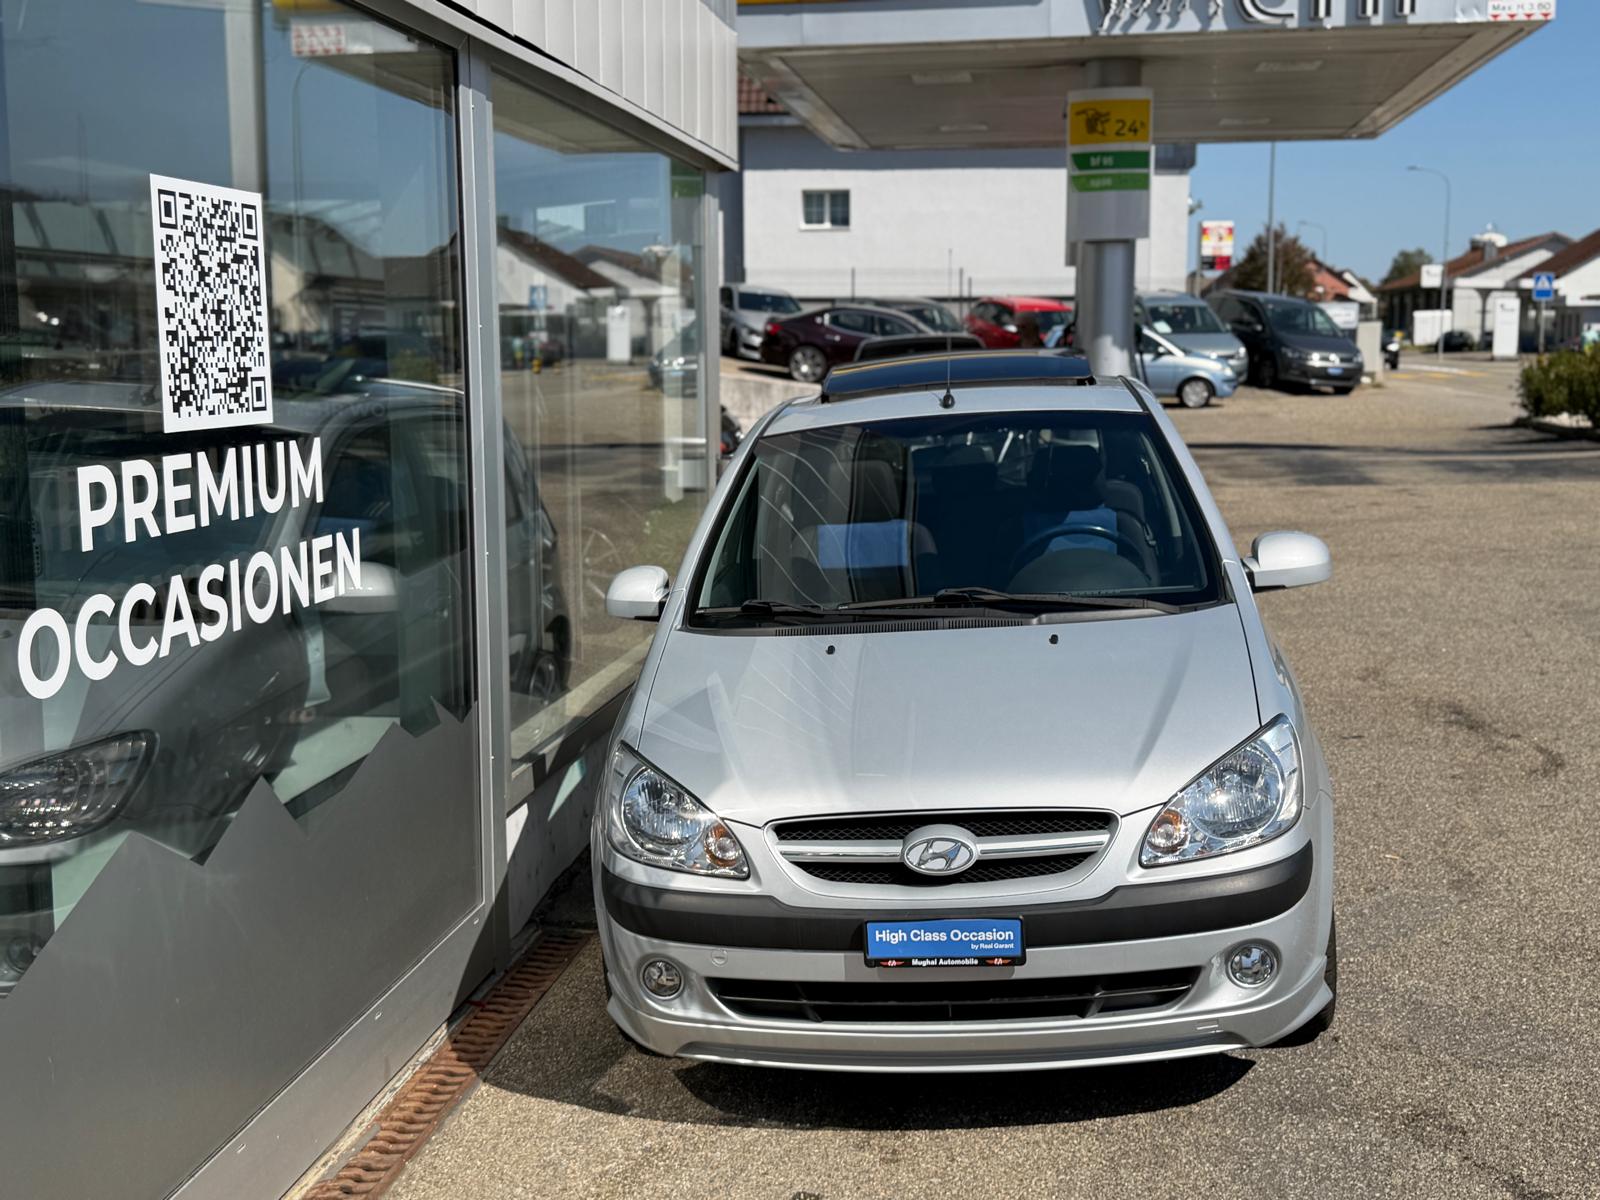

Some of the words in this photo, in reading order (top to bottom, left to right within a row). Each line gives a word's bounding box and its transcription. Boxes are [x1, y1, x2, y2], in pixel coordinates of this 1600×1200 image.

[77, 437, 324, 552] PREMIUM
[17, 527, 361, 699] OCCASIONEN
[875, 929, 907, 944] High
[910, 929, 947, 942] Class
[950, 928, 1014, 941] Occasion
[911, 958, 938, 967] Mughal
[938, 957, 979, 965] Automobile
